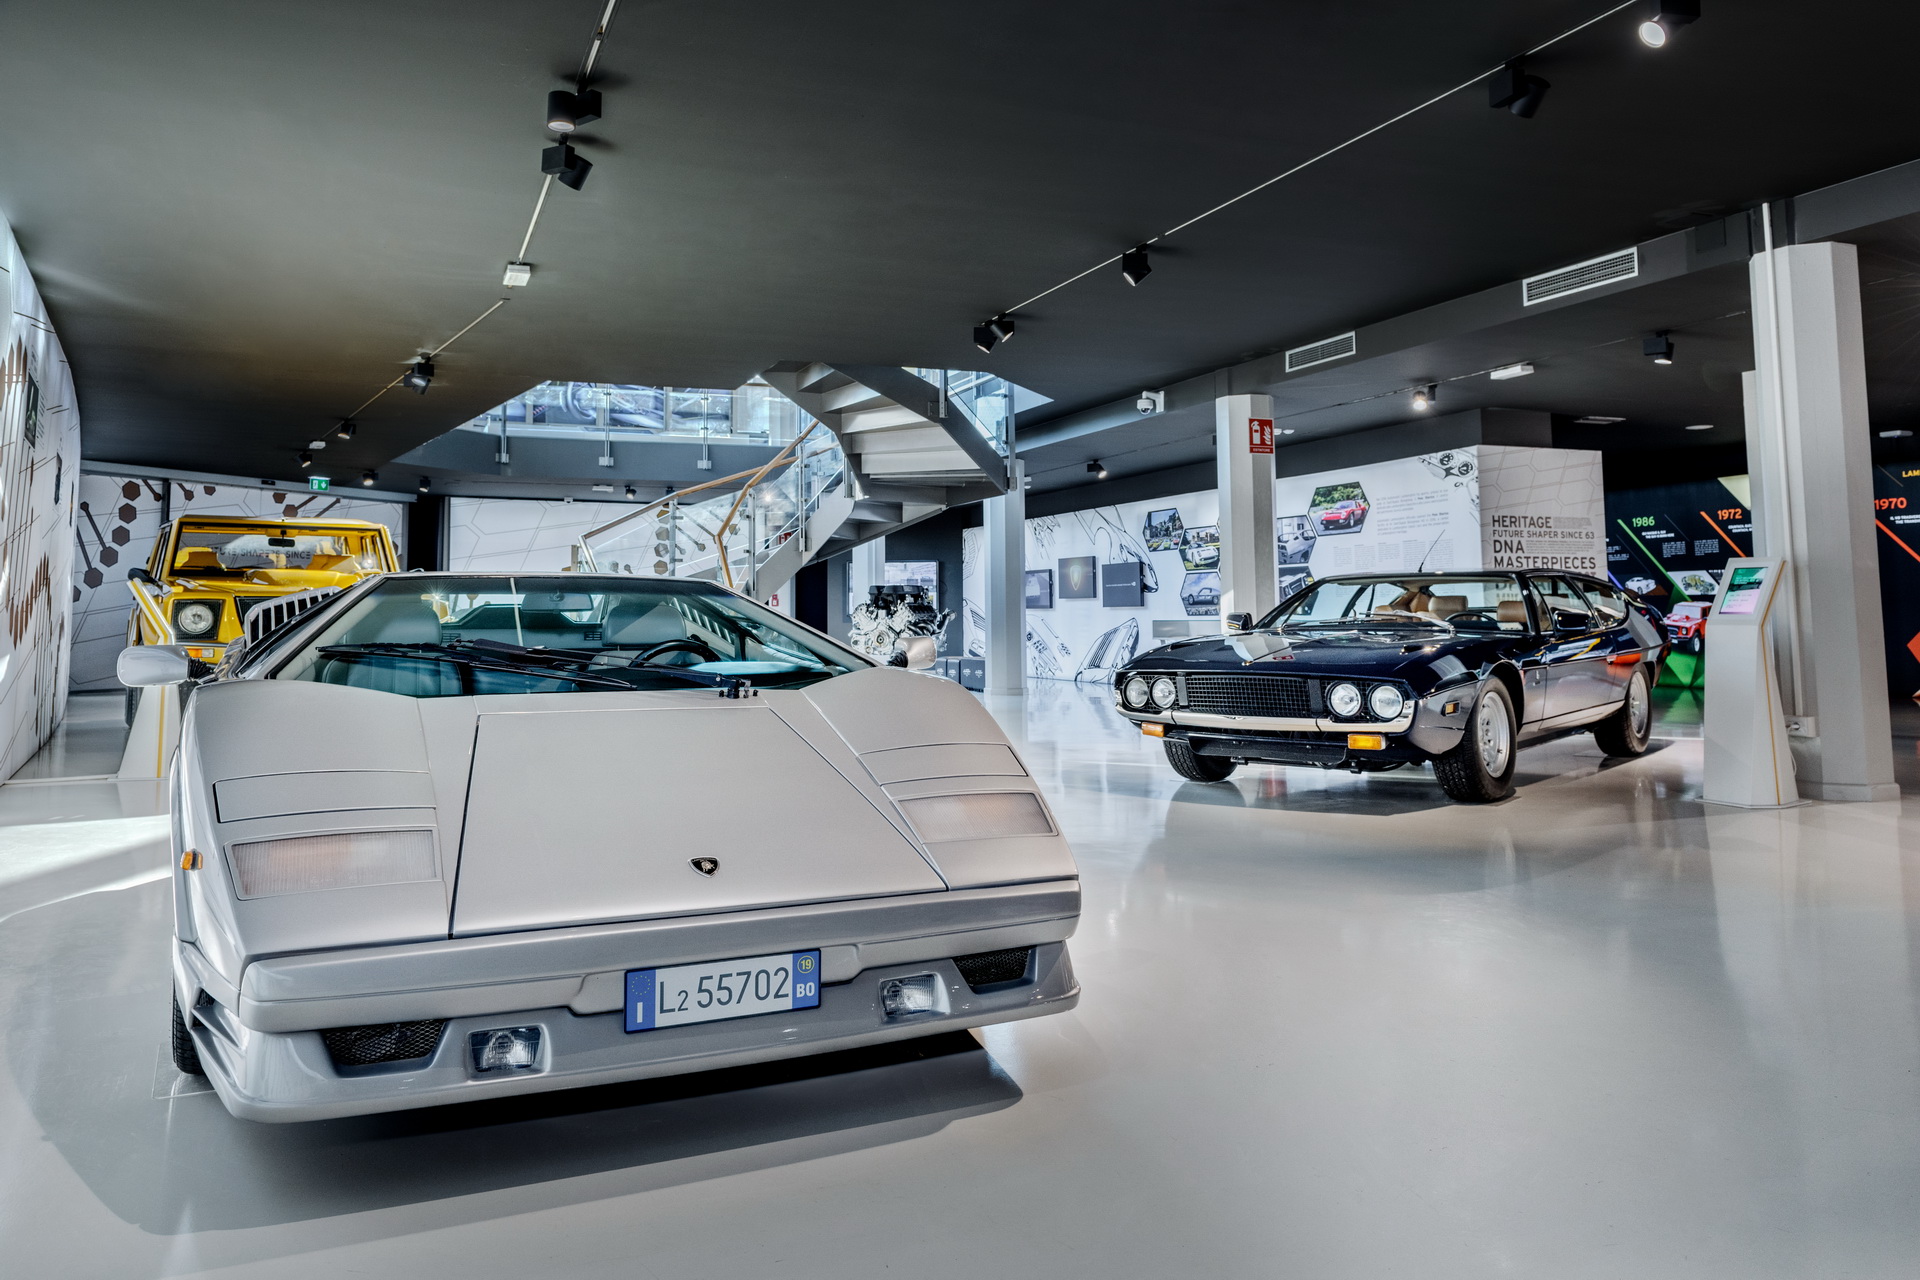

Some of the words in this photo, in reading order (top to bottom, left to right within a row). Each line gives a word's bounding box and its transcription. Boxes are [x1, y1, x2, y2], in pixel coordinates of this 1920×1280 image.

[1873, 497, 1908, 510] 1970
[1717, 508, 1743, 520] 1972
[1492, 515, 1552, 529] HERITAGE
[1632, 516, 1655, 527] 1986
[1492, 529, 1524, 538] FUTURE
[1527, 530, 1559, 539] SHAPER
[1560, 531, 1584, 539] SINCE
[1585, 531, 1595, 540] 63
[1493, 539, 1525, 554] DNA
[285, 550, 311, 559] SINCE
[1494, 556, 1597, 570] MASTERPIECES
[800, 958, 812, 970] 19
[697, 967, 789, 1008] 55702
[796, 982, 815, 998] BO
[636, 1001, 643, 1024] I
